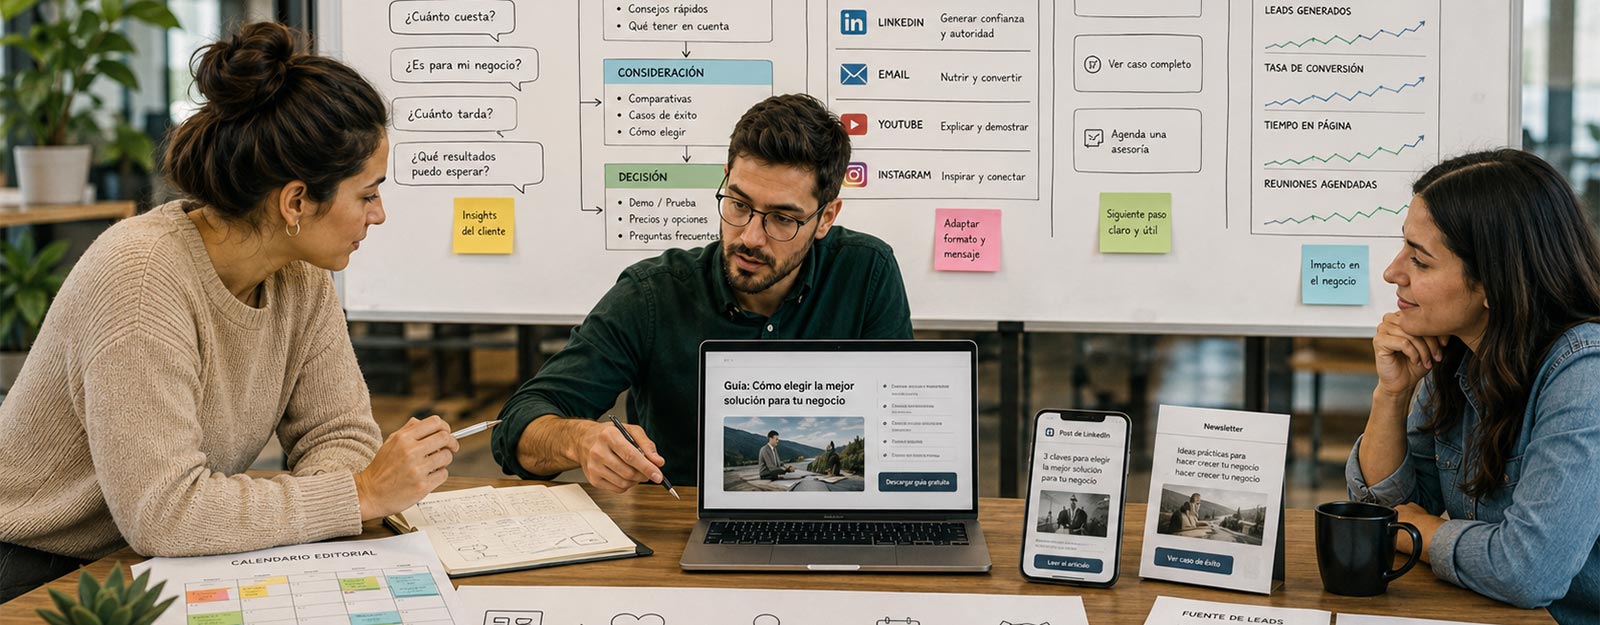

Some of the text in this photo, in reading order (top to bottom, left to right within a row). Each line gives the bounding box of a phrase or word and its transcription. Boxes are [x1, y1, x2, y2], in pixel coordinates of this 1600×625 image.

[628, 4, 708, 16] Consejos rápidos
[1265, 6, 1351, 16] LEADS GENERADOS
[406, 10, 495, 24] ¿Cuánto cuesta?
[878, 18, 924, 27] LINKEDIN
[940, 13, 1024, 23] Generar confianza
[629, 21, 648, 32] Qué
[653, 22, 678, 30] tener
[697, 22, 729, 30] cuenta
[940, 29, 994, 41] y autoridad
[406, 59, 521, 73] ¿Es para mi negocio?
[1108, 59, 1191, 71] Ver caso completo
[1265, 62, 1364, 73] TASA DE CONVERSIÓN
[618, 66, 704, 77] CONSIDERACIÓN
[878, 70, 909, 79] EMAIL
[941, 73, 1022, 85] Nutrir y convertir
[629, 94, 692, 106] Comparativas
[408, 108, 493, 122] ¿Cuánto tarda?
[629, 110, 697, 120] Casos de éxito
[878, 120, 923, 129] YOUTUBE
[941, 122, 1028, 134] Explicar y demostrar
[1264, 119, 1351, 130] TIEMPO EN PÁGINA
[629, 127, 686, 140] Cómo elegir
[1112, 130, 1166, 142] Agenda una
[1111, 145, 1149, 154] asesoría
[412, 151, 496, 164] ¿Qué resultados
[412, 166, 489, 179] puedo esperar?
[619, 170, 667, 182] DECISIÓN
[878, 170, 931, 179] INSTAGRAM
[942, 172, 1026, 184] Inspirar y conectar
[1264, 179, 1377, 189] REUNIONES AGENDADAS
[630, 198, 696, 207] Demo / Prueba
[463, 210, 497, 223] Insights
[630, 214, 708, 226] Precios y opciones
[1107, 209, 1166, 222] Siguiente paso
[462, 226, 505, 236] del cliente
[944, 219, 979, 231] Adaptar
[1108, 225, 1157, 237] claro y útil
[630, 231, 719, 243] Preguntas frecuentes
[944, 234, 986, 246] formato y
[944, 249, 980, 261] mensaje
[1311, 260, 1345, 272] Impacto
[1311, 276, 1356, 288] el negocio
[752, 381, 781, 390] Cómo
[784, 381, 812, 392] elegir
[815, 381, 823, 390] la
[826, 381, 854, 392] mejor
[724, 396, 845, 407] solución para tu negocio
[1204, 423, 1243, 432] Newsletter
[1050, 453, 1071, 461] claves
[1090, 456, 1110, 465] elegir
[1197, 449, 1229, 457] prácticas
[1051, 465, 1071, 473] mejor
[1198, 460, 1219, 468] crecer
[1231, 463, 1259, 472] negocio
[1069, 477, 1097, 485] negocio
[1175, 469, 1195, 477] hacer
[1231, 475, 1260, 483] negocio
[231, 550, 377, 566] CALENDARIO EDITORIAL
[1205, 559, 1220, 567] éxito
[1182, 611, 1225, 620] FUENTE
